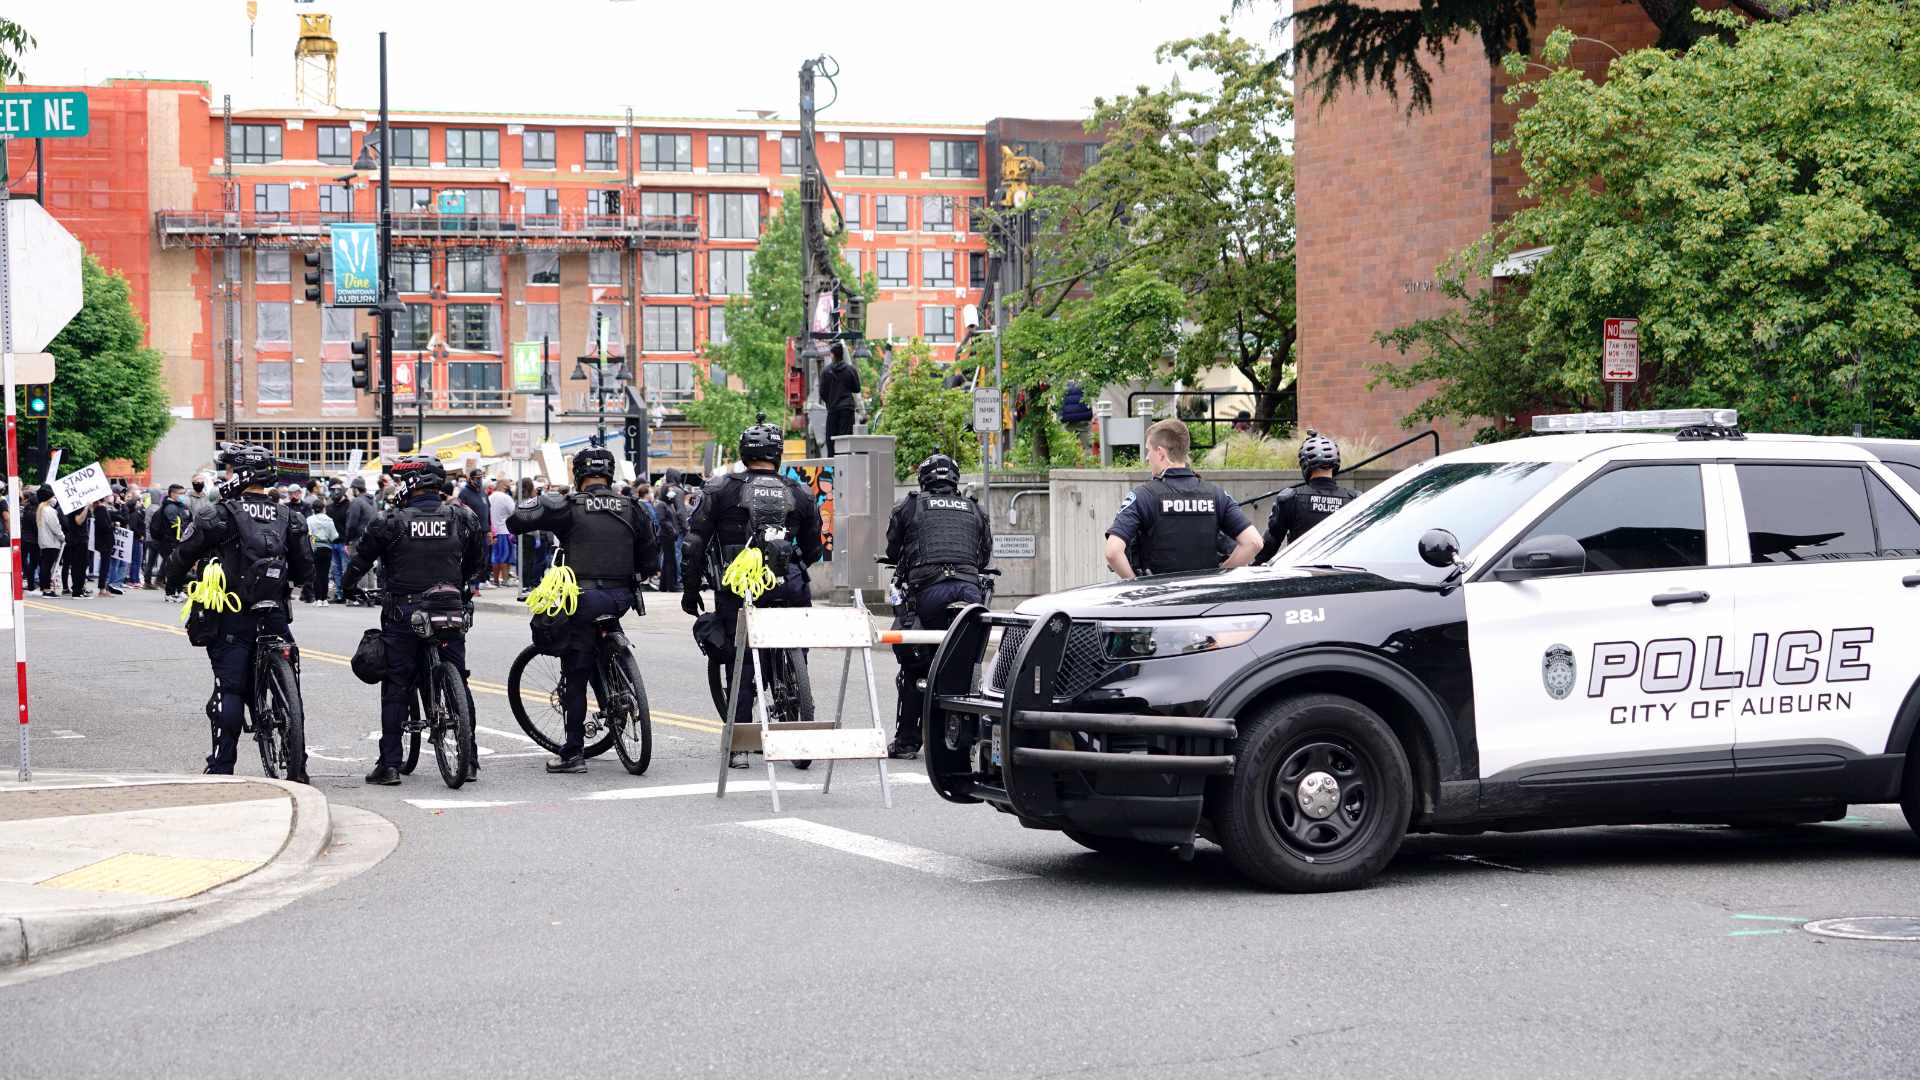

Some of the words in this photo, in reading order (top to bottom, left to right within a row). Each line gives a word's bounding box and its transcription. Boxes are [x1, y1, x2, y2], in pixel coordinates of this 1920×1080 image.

[44, 98, 76, 131] NE
[344, 272, 369, 289] Dine
[337, 295, 376, 303] AUBURN
[1607, 324, 1619, 337] NO
[62, 468, 95, 488] STAND
[65, 486, 78, 498] IN
[754, 488, 784, 498] POLICE
[242, 503, 277, 521] POLICE
[586, 499, 622, 511] POLICE
[930, 499, 968, 510] POLICE
[1162, 499, 1215, 513] POLICE
[1312, 503, 1341, 512] POLICE
[411, 521, 447, 537] POLICE
[1284, 607, 1326, 625] 28J
[1586, 626, 1875, 698] POLICE
[1609, 702, 1677, 725] CITY
[1690, 699, 1731, 719] OF
[1740, 691, 1853, 716] AUBURN
